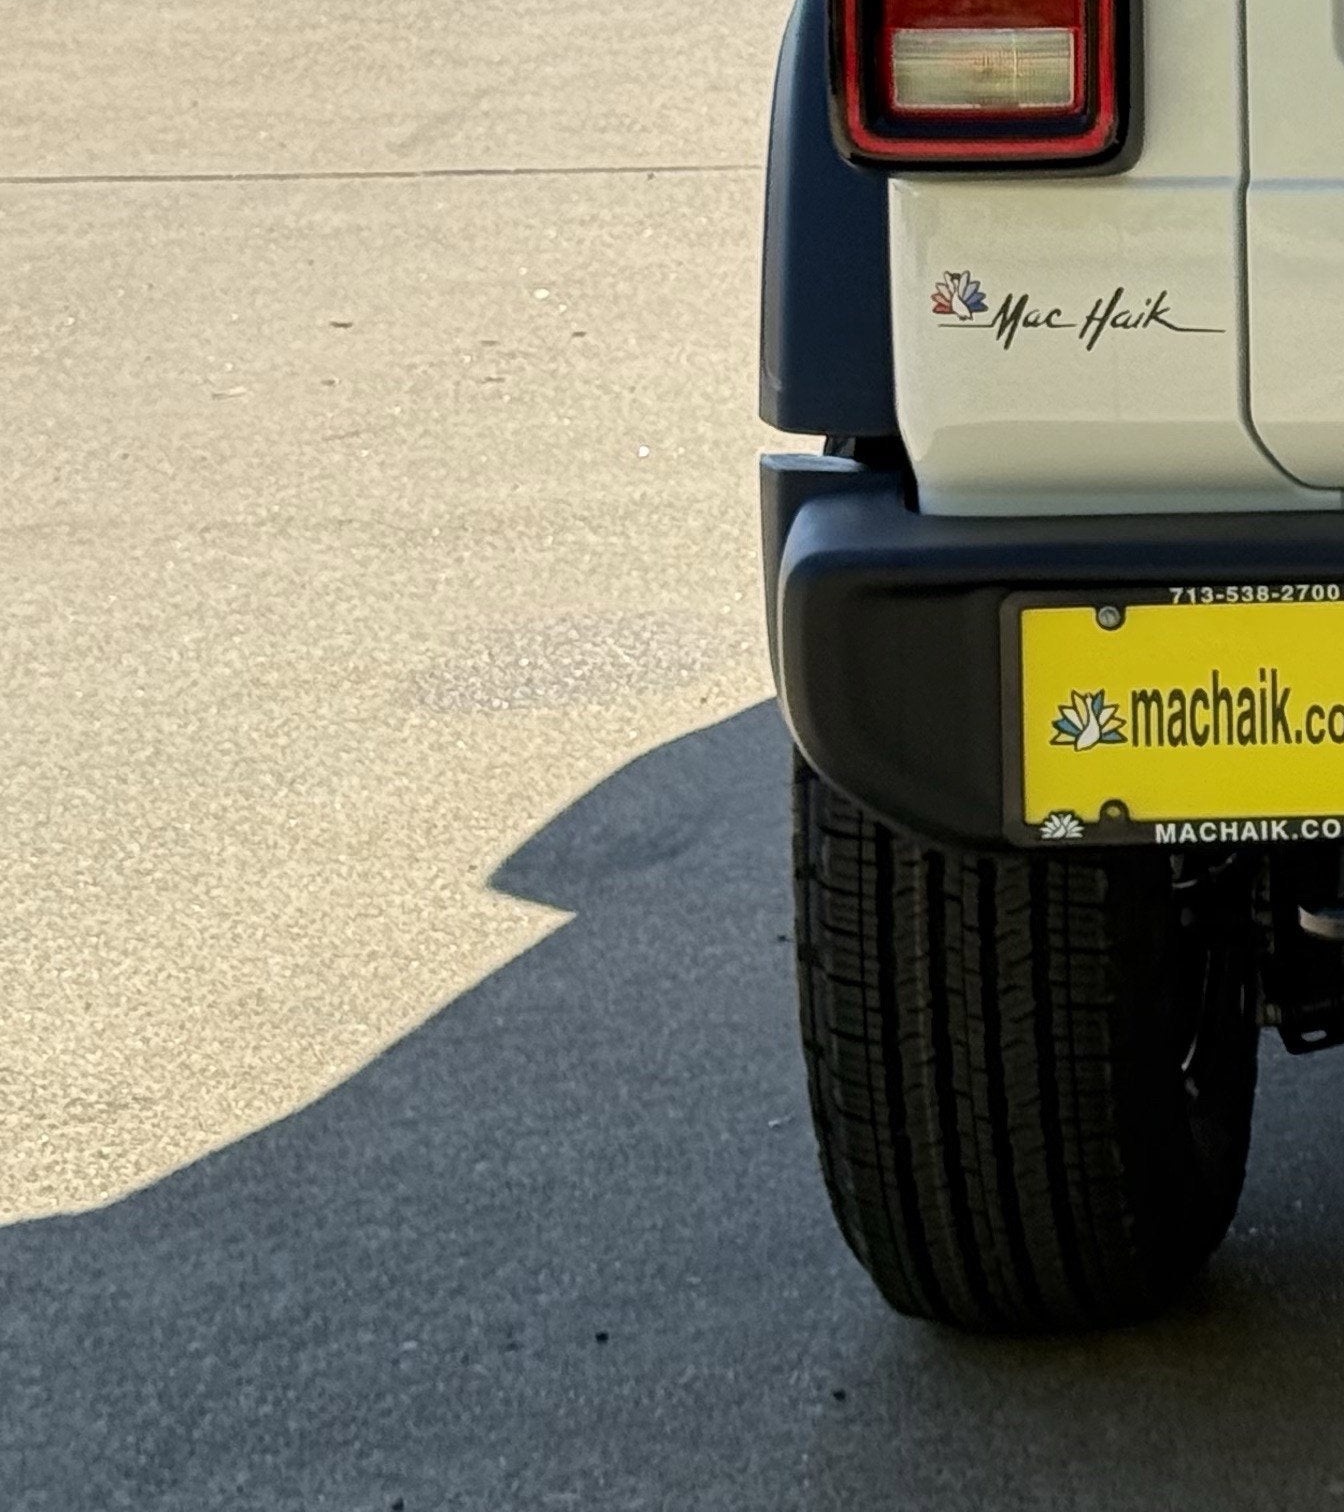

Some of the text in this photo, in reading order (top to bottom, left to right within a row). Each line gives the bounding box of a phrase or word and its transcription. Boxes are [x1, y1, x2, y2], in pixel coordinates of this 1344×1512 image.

[987, 287, 1208, 351] Mac Haik
[1170, 584, 1341, 604] 713-538-2700
